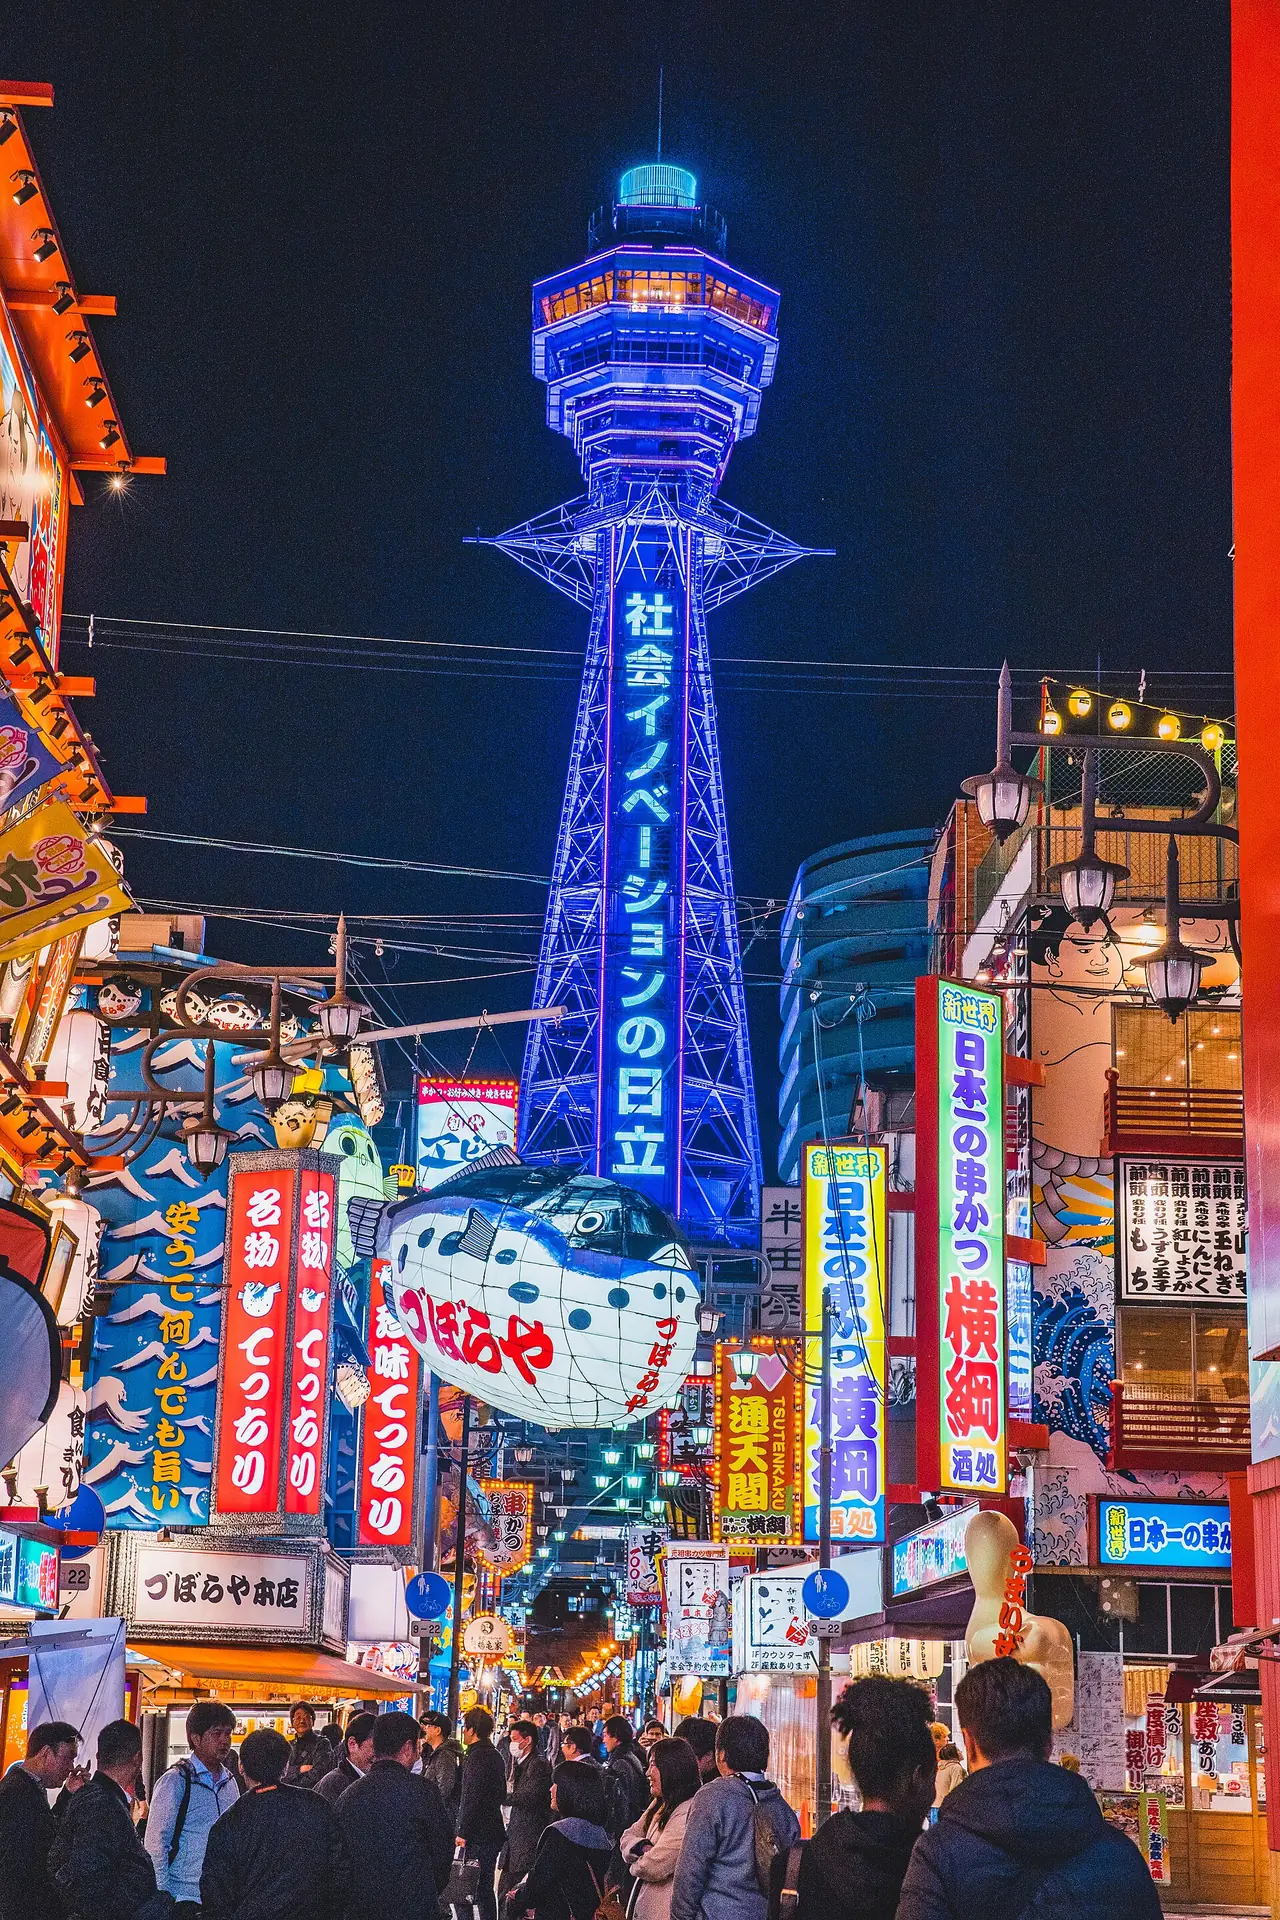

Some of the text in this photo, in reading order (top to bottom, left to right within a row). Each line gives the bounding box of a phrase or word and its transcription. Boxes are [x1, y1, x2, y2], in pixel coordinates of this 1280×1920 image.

[612, 592, 674, 1175] 社会イノベーションの日立
[942, 989, 996, 1032] 新世界
[811, 1151, 879, 1177] 新世界
[952, 1031, 989, 1269] 日本一の串かつ
[1129, 1166, 1148, 1197] 前頭
[1170, 1167, 1190, 1198] 前頭
[1191, 1168, 1211, 1199] 前頭
[1212, 1168, 1232, 1200] 前頭
[1130, 1227, 1148, 1292] もち
[1172, 1228, 1192, 1293] 紅しょうが
[1192, 1229, 1212, 1294] にんにく
[1213, 1230, 1234, 1294] 玉ねぎ
[231, 1188, 282, 1495] 名物 てっちり
[290, 1189, 330, 1496] 名物 てっちり
[390, 1287, 554, 1385] づぼらや
[625, 1315, 682, 1412] づぼらや
[945, 1275, 998, 1442] 横綱
[727, 1395, 770, 1511] 通天閣
[771, 1396, 786, 1511] TSUTENKAKU
[811, 1375, 878, 1502] 横綱
[953, 1448, 996, 1484] 酒処
[503, 1493, 525, 1550] 串かつ
[746, 1514, 786, 1535] 横綱
[1108, 1508, 1126, 1558] 新世界
[144, 1571, 299, 1609] づぼらや本店
[412, 1625, 440, 1634] 9-22
[761, 1651, 811, 1660] カウンター席
[811, 1624, 840, 1634] 9-22
[761, 1661, 811, 1670] 座敷あります
[1146, 1692, 1165, 1766] 二度漬け
